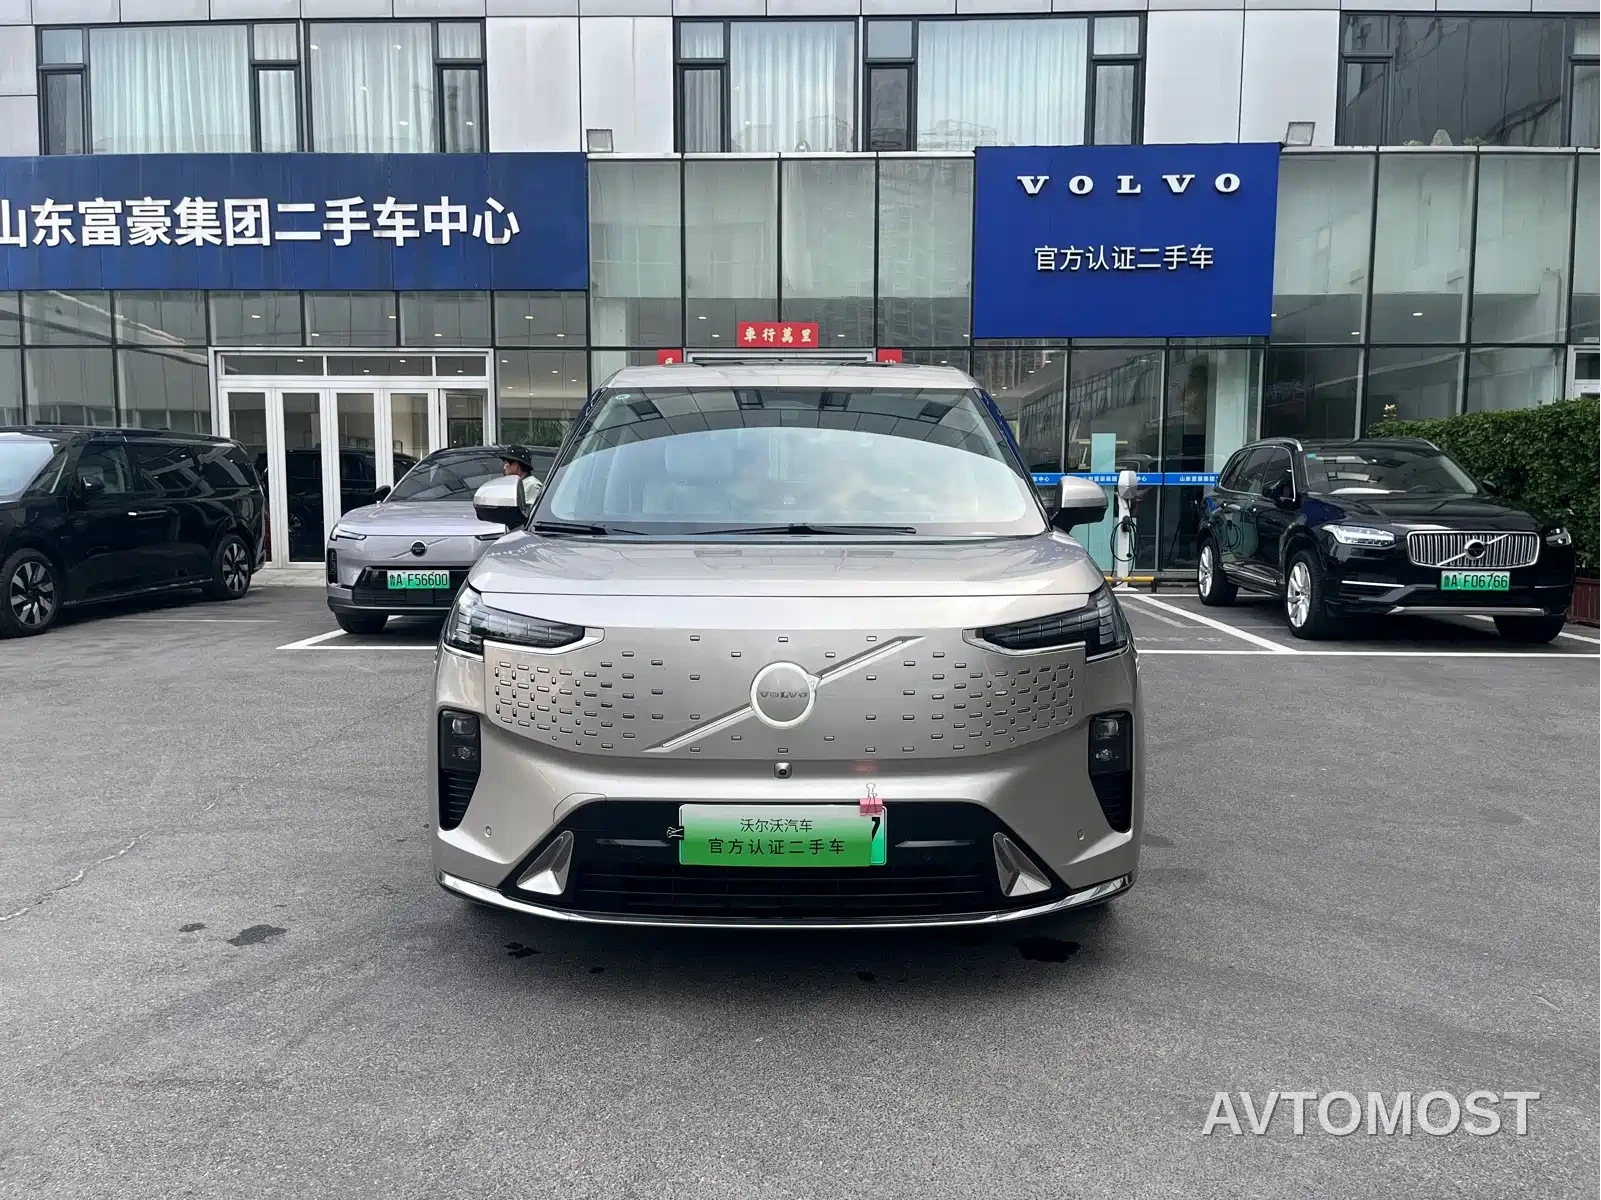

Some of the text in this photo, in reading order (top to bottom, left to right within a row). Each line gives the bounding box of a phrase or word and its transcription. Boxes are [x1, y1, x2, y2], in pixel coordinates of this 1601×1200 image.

[1016, 173, 1241, 195] VOLVO
[0, 196, 521, 248] 山东富豪集团二手车中心
[1034, 244, 1215, 272] 官方认证二手车
[743, 326, 813, 344] 車行萬里
[740, 818, 814, 833] 沃尔沃汽车
[708, 838, 845, 855] 官方认证二手车
